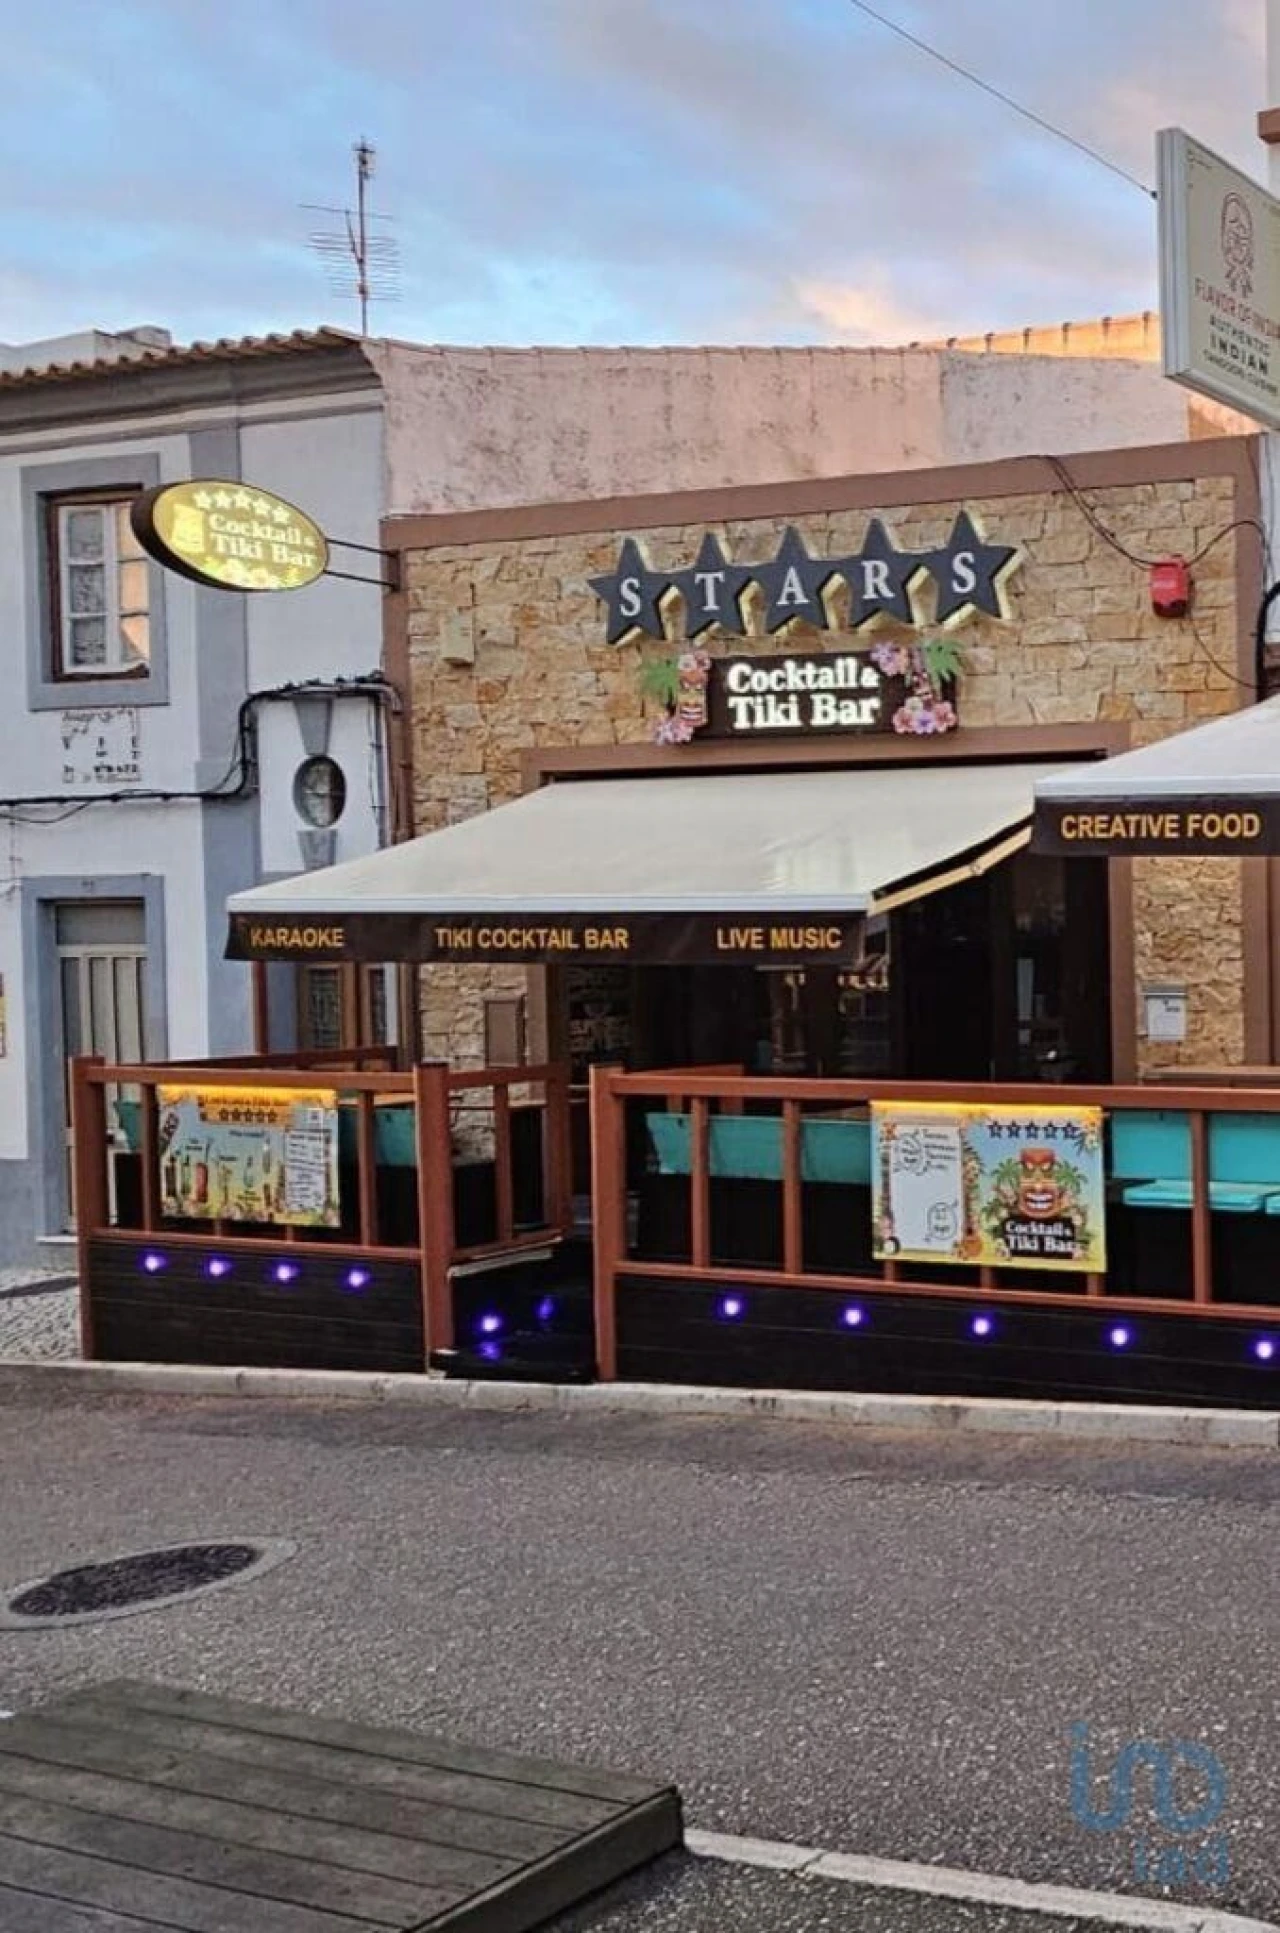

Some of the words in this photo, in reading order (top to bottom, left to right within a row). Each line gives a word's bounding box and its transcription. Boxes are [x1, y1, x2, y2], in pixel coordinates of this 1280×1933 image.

[1209, 331, 1269, 375] INDIAN
[208, 512, 301, 545] Cocktail
[209, 532, 263, 560] Tiki
[271, 543, 318, 567] Bar
[618, 551, 977, 618] STARS
[727, 657, 859, 695] Cocktail
[727, 694, 802, 731] Tiki
[810, 692, 881, 728] Bar
[1061, 814, 1179, 839] CREATIVE
[1187, 812, 1261, 838] FOOD
[250, 926, 345, 948] KARAOKE
[434, 927, 473, 948] TIKI
[477, 927, 579, 949] COCKTAIL
[584, 927, 630, 949] BAR
[716, 927, 766, 949] LIVE
[770, 926, 843, 949] MUSIC
[1006, 1234, 1039, 1251] Tiki
